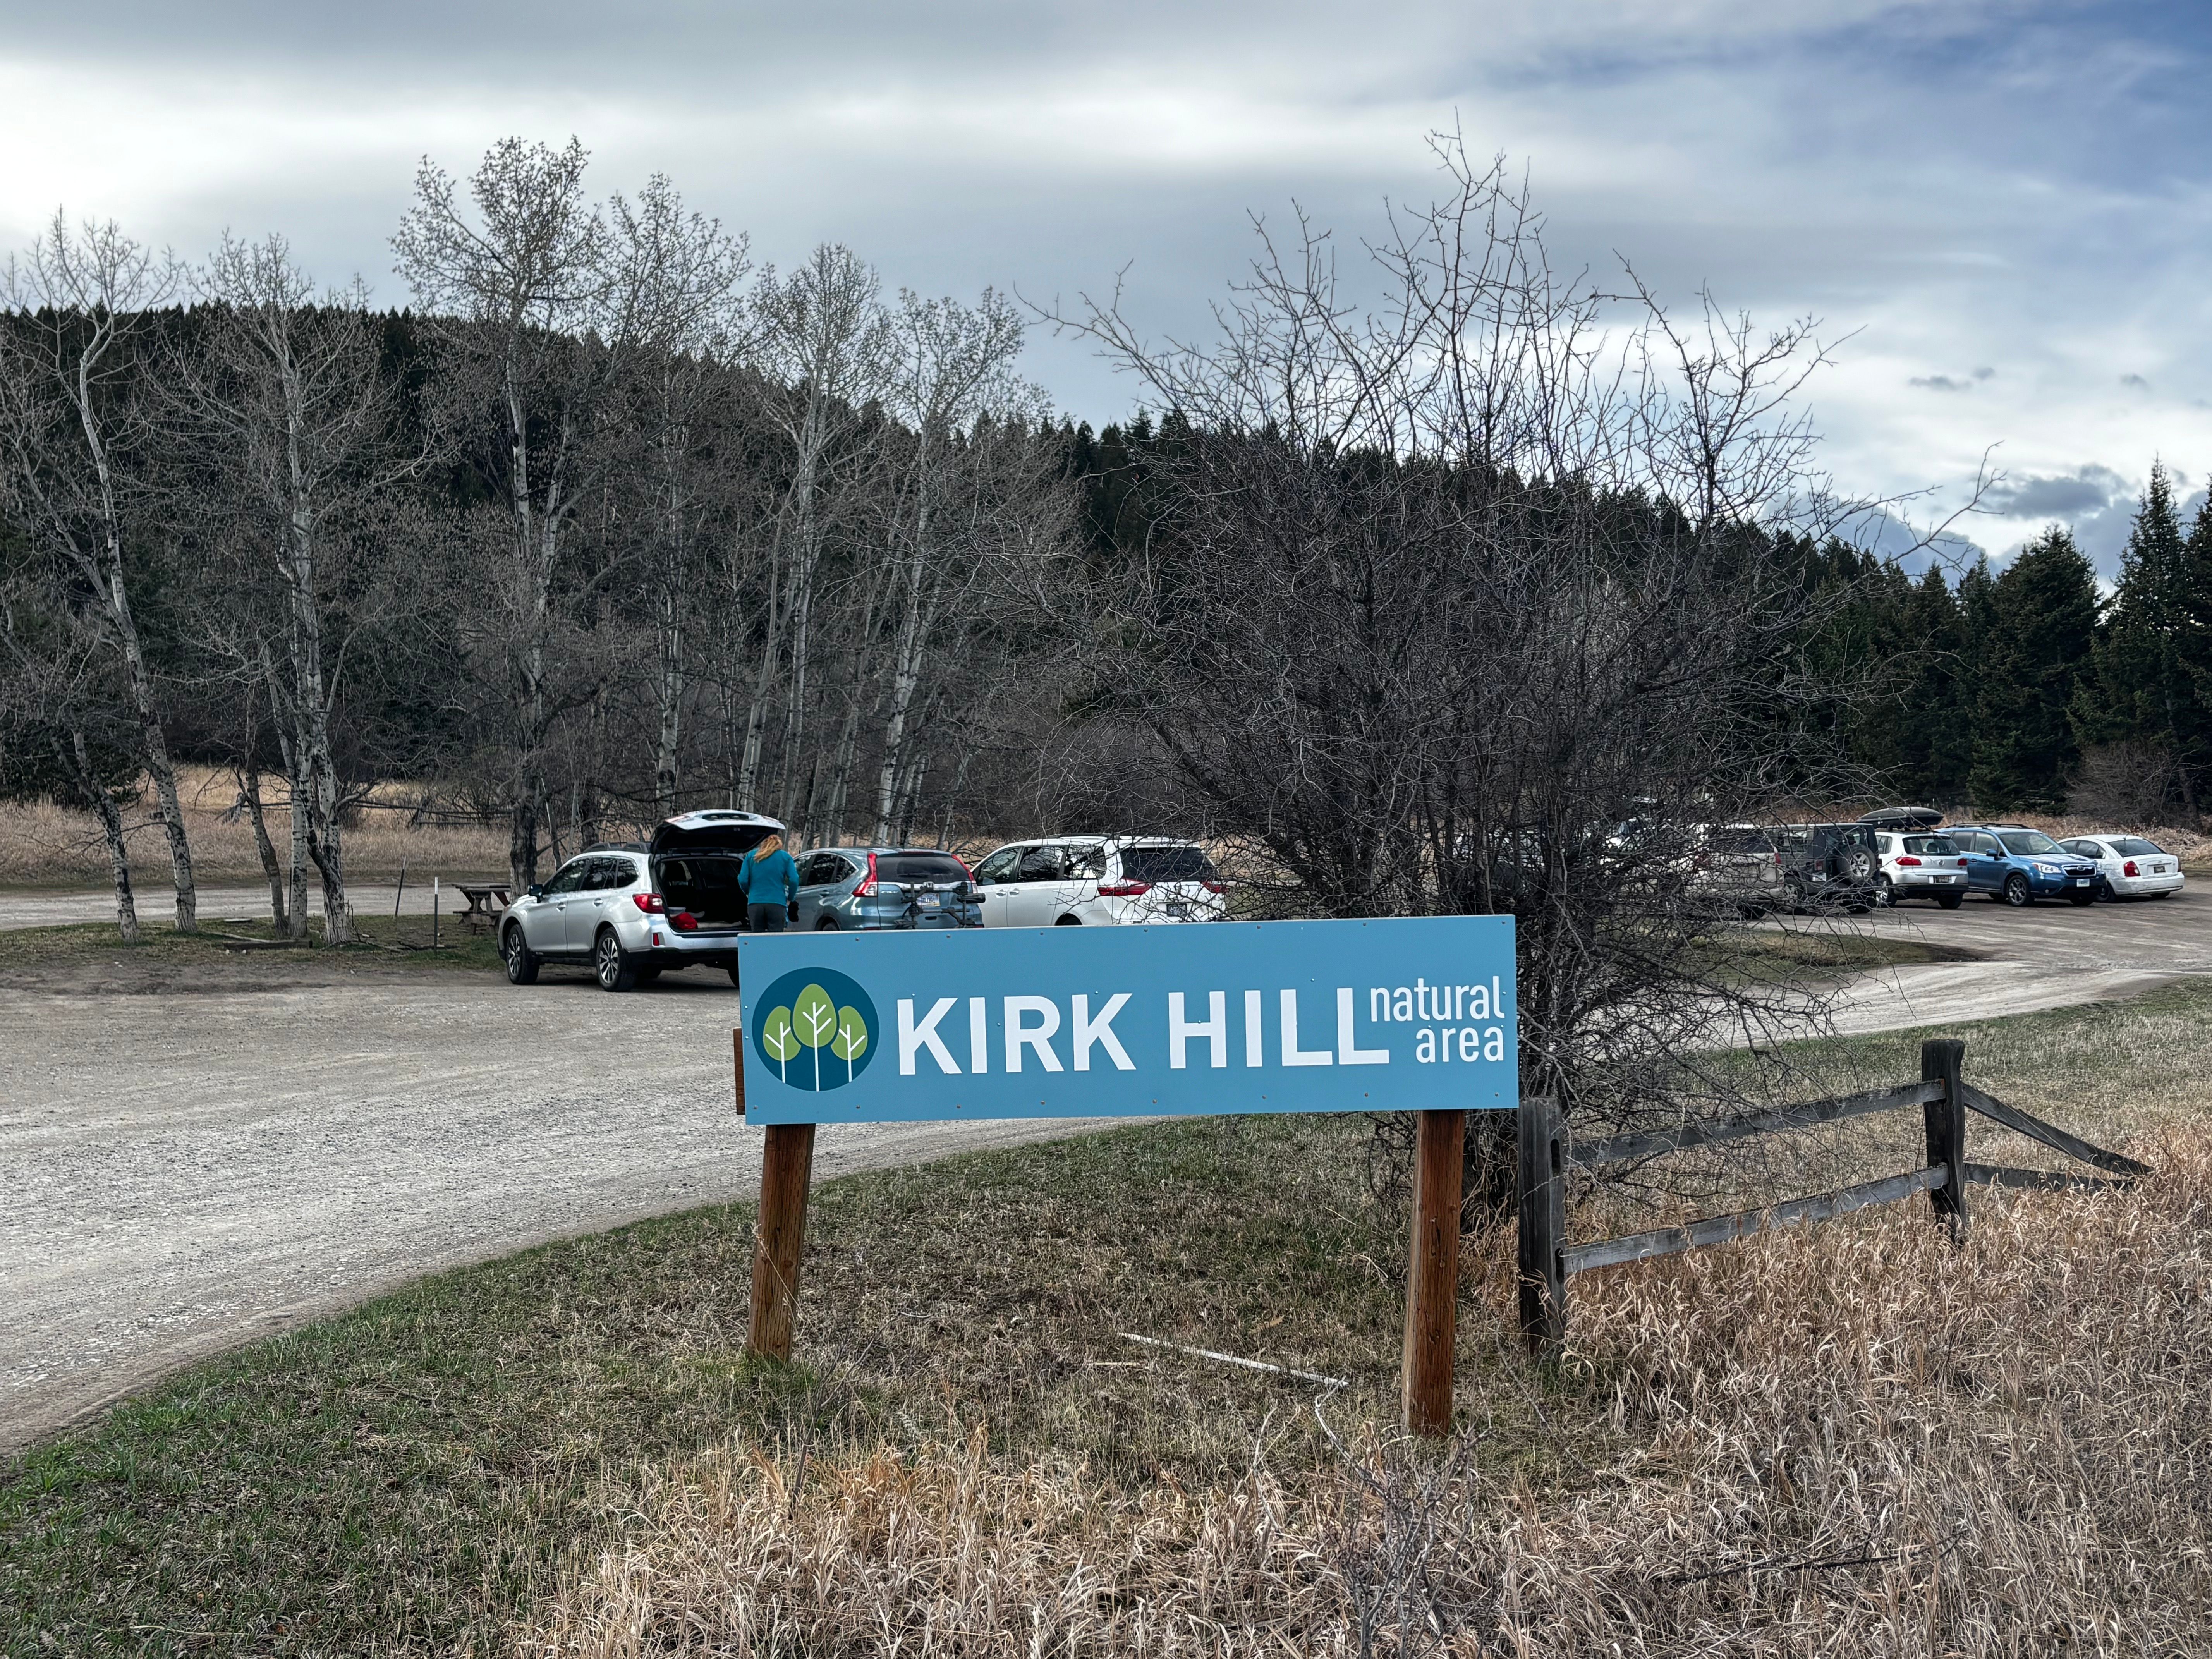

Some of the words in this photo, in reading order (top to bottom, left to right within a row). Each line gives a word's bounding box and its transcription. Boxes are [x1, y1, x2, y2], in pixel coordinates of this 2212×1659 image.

[1370, 975, 1505, 1022] natural
[897, 993, 1137, 1075] KIRK
[1168, 988, 1390, 1069] HILL
[1415, 1026, 1504, 1063] area
